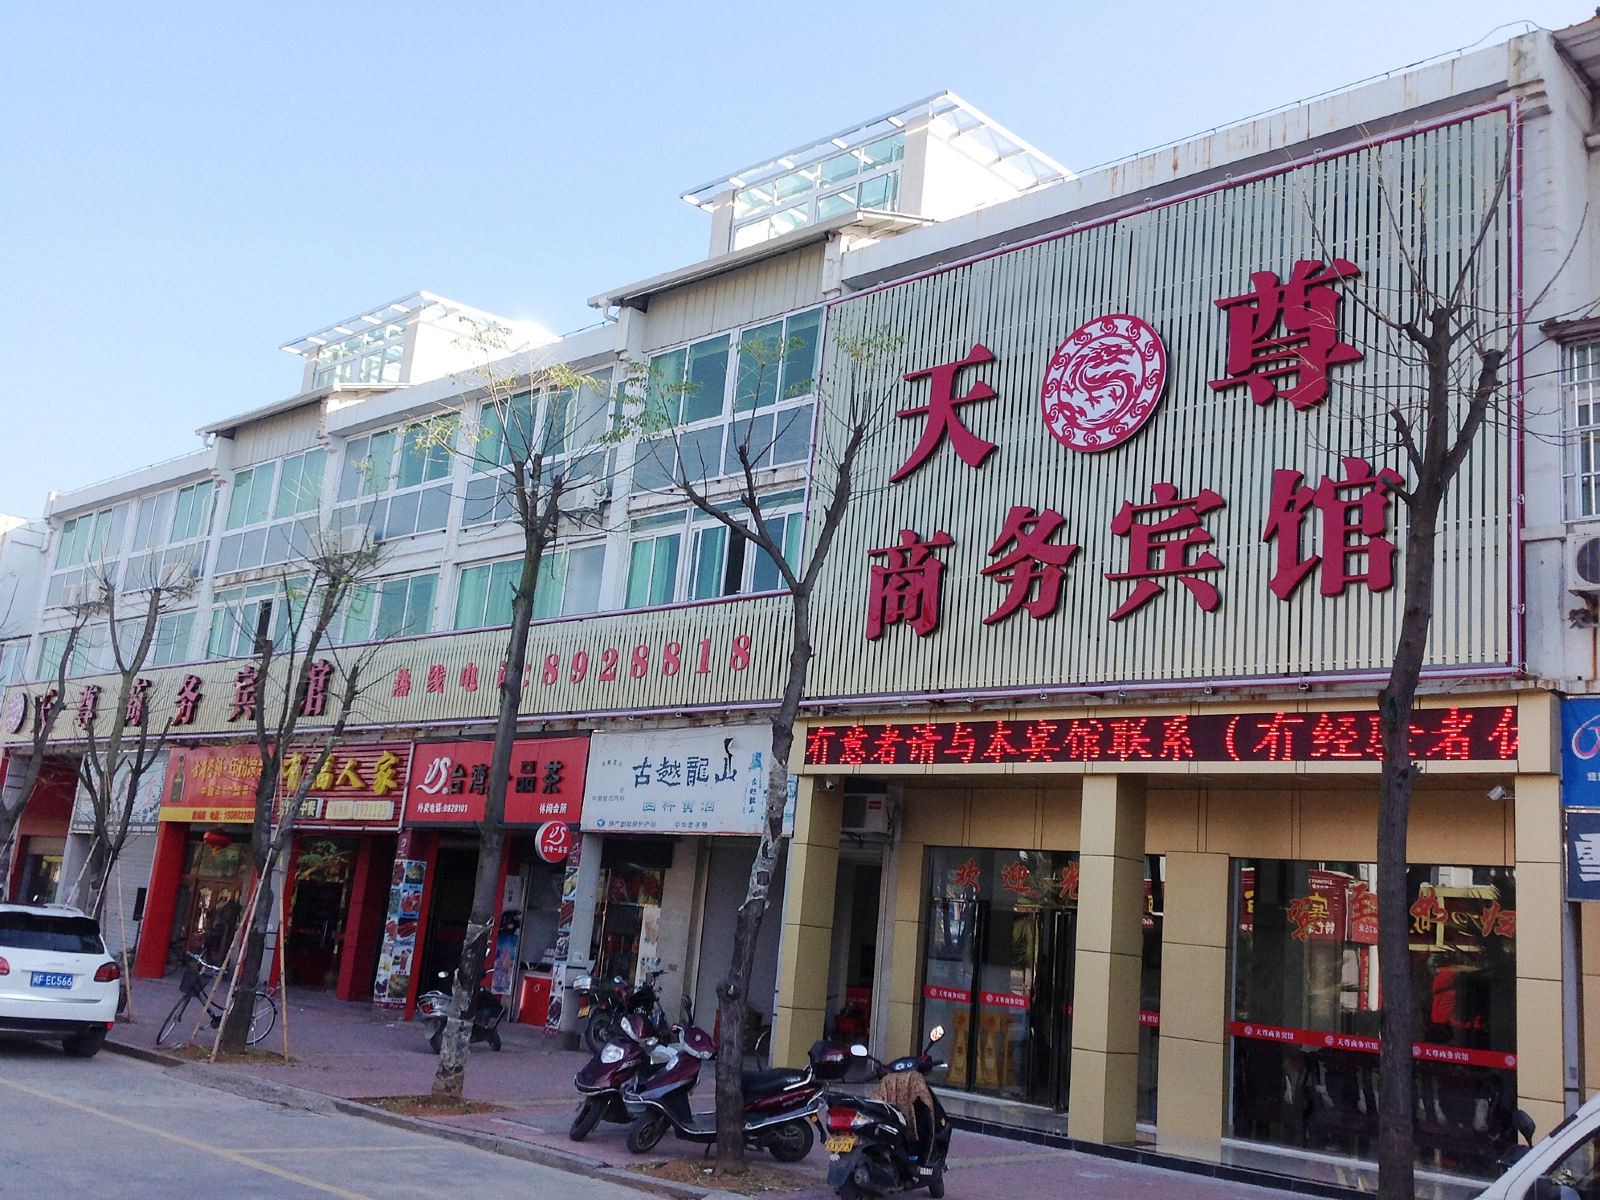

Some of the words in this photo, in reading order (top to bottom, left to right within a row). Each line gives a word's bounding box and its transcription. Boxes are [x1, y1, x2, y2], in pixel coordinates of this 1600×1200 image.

[866, 456, 1405, 641] 商务宾馆
[449, 761, 564, 796] 台湾品茶
